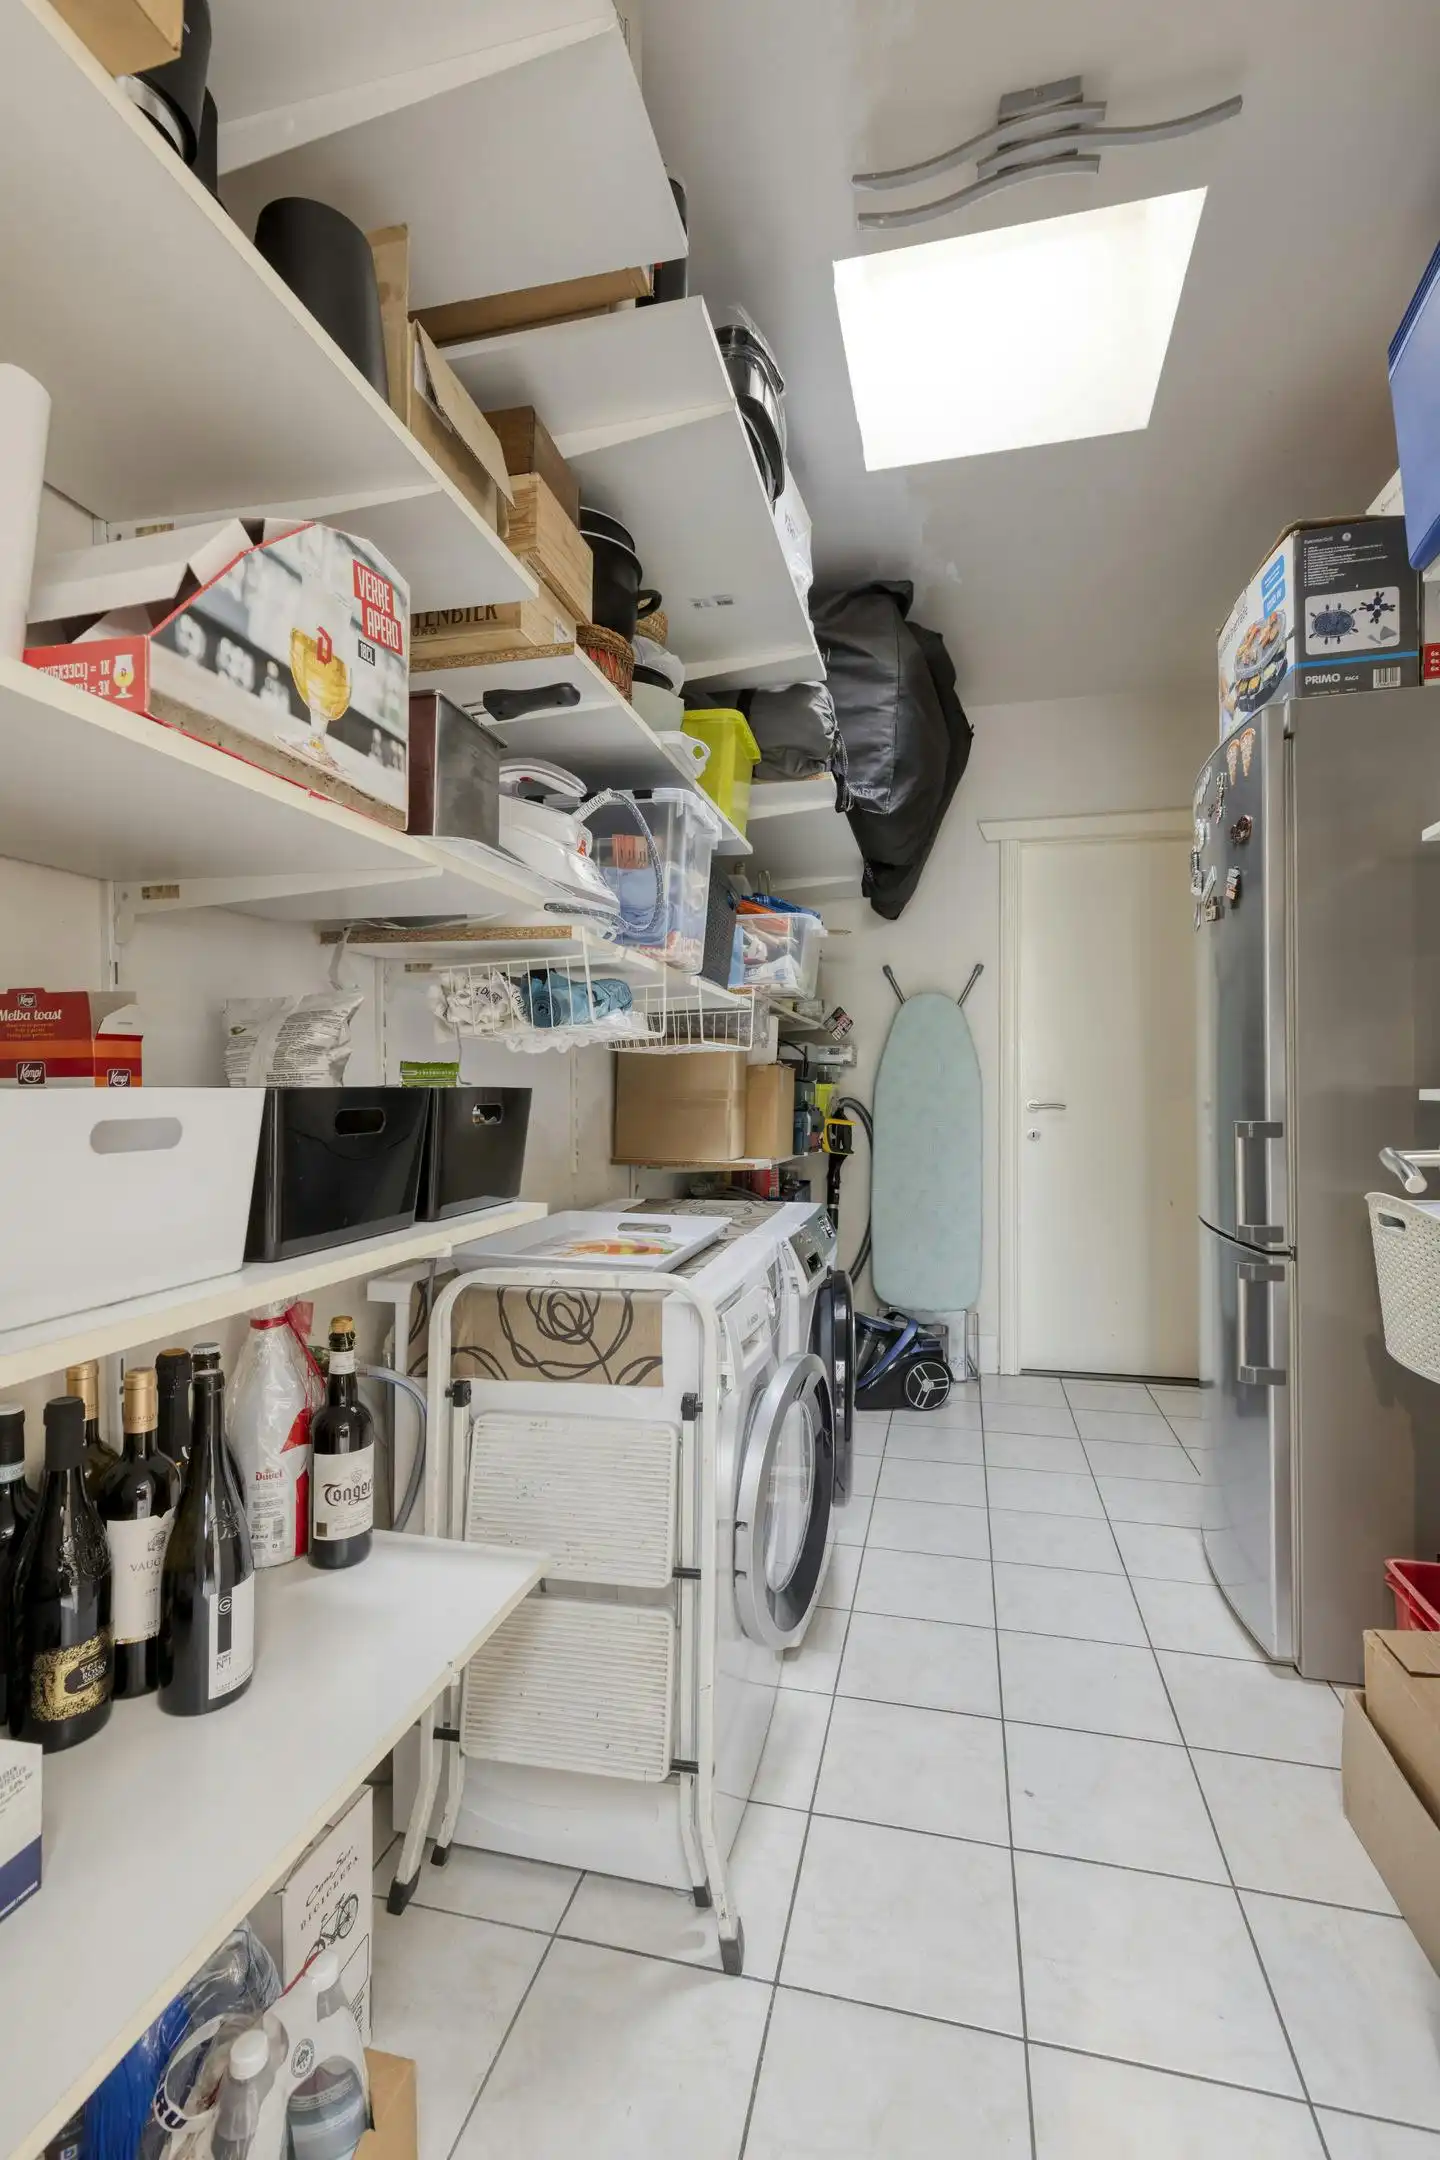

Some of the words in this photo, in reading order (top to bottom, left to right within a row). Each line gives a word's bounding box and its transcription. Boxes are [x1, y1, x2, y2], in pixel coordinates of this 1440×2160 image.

[357, 566, 391, 613] VERRE
[1304, 673, 1341, 686] PRIMO
[0, 1009, 31, 1022] Melba
[34, 1008, 62, 1021] toast
[19, 1063, 44, 1081] Kempi
[109, 1069, 130, 1087] Kempi
[255, 1469, 283, 1481] Duvel
